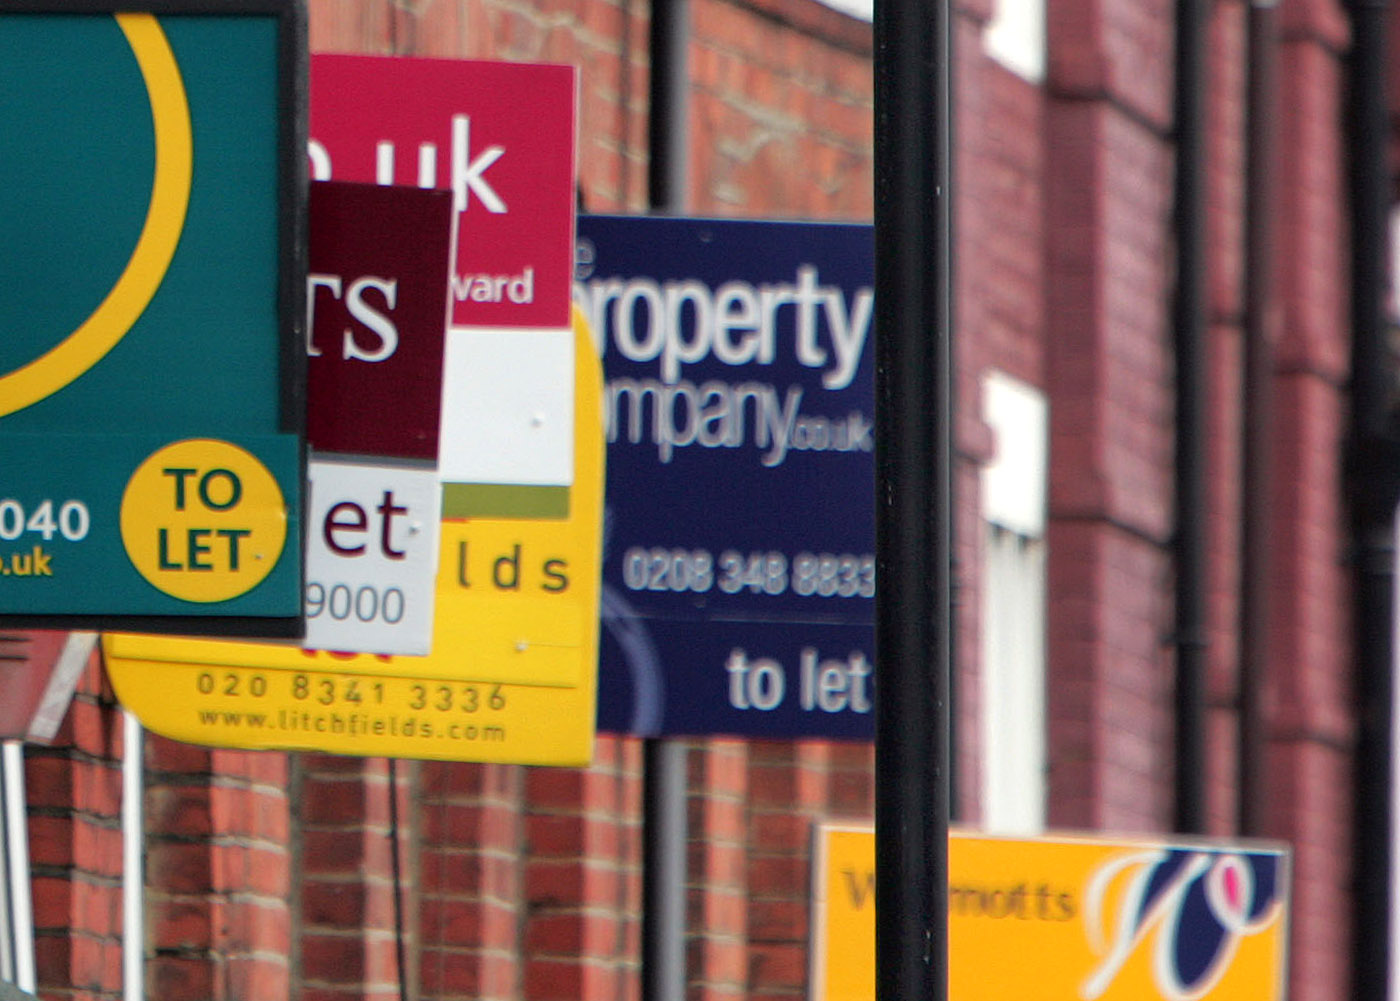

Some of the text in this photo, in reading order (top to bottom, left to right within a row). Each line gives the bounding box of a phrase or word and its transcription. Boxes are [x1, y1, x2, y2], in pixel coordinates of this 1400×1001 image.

[603, 377, 874, 467] mpany.co.uk
[163, 468, 242, 511] TO
[157, 530, 251, 571] LET
[623, 547, 875, 598] 0208 348 8833
[305, 582, 406, 625] 9000
[197, 673, 506, 713] 020 8341 3336
[724, 647, 873, 713] to let
[199, 709, 506, 743] www.litchfields.com
